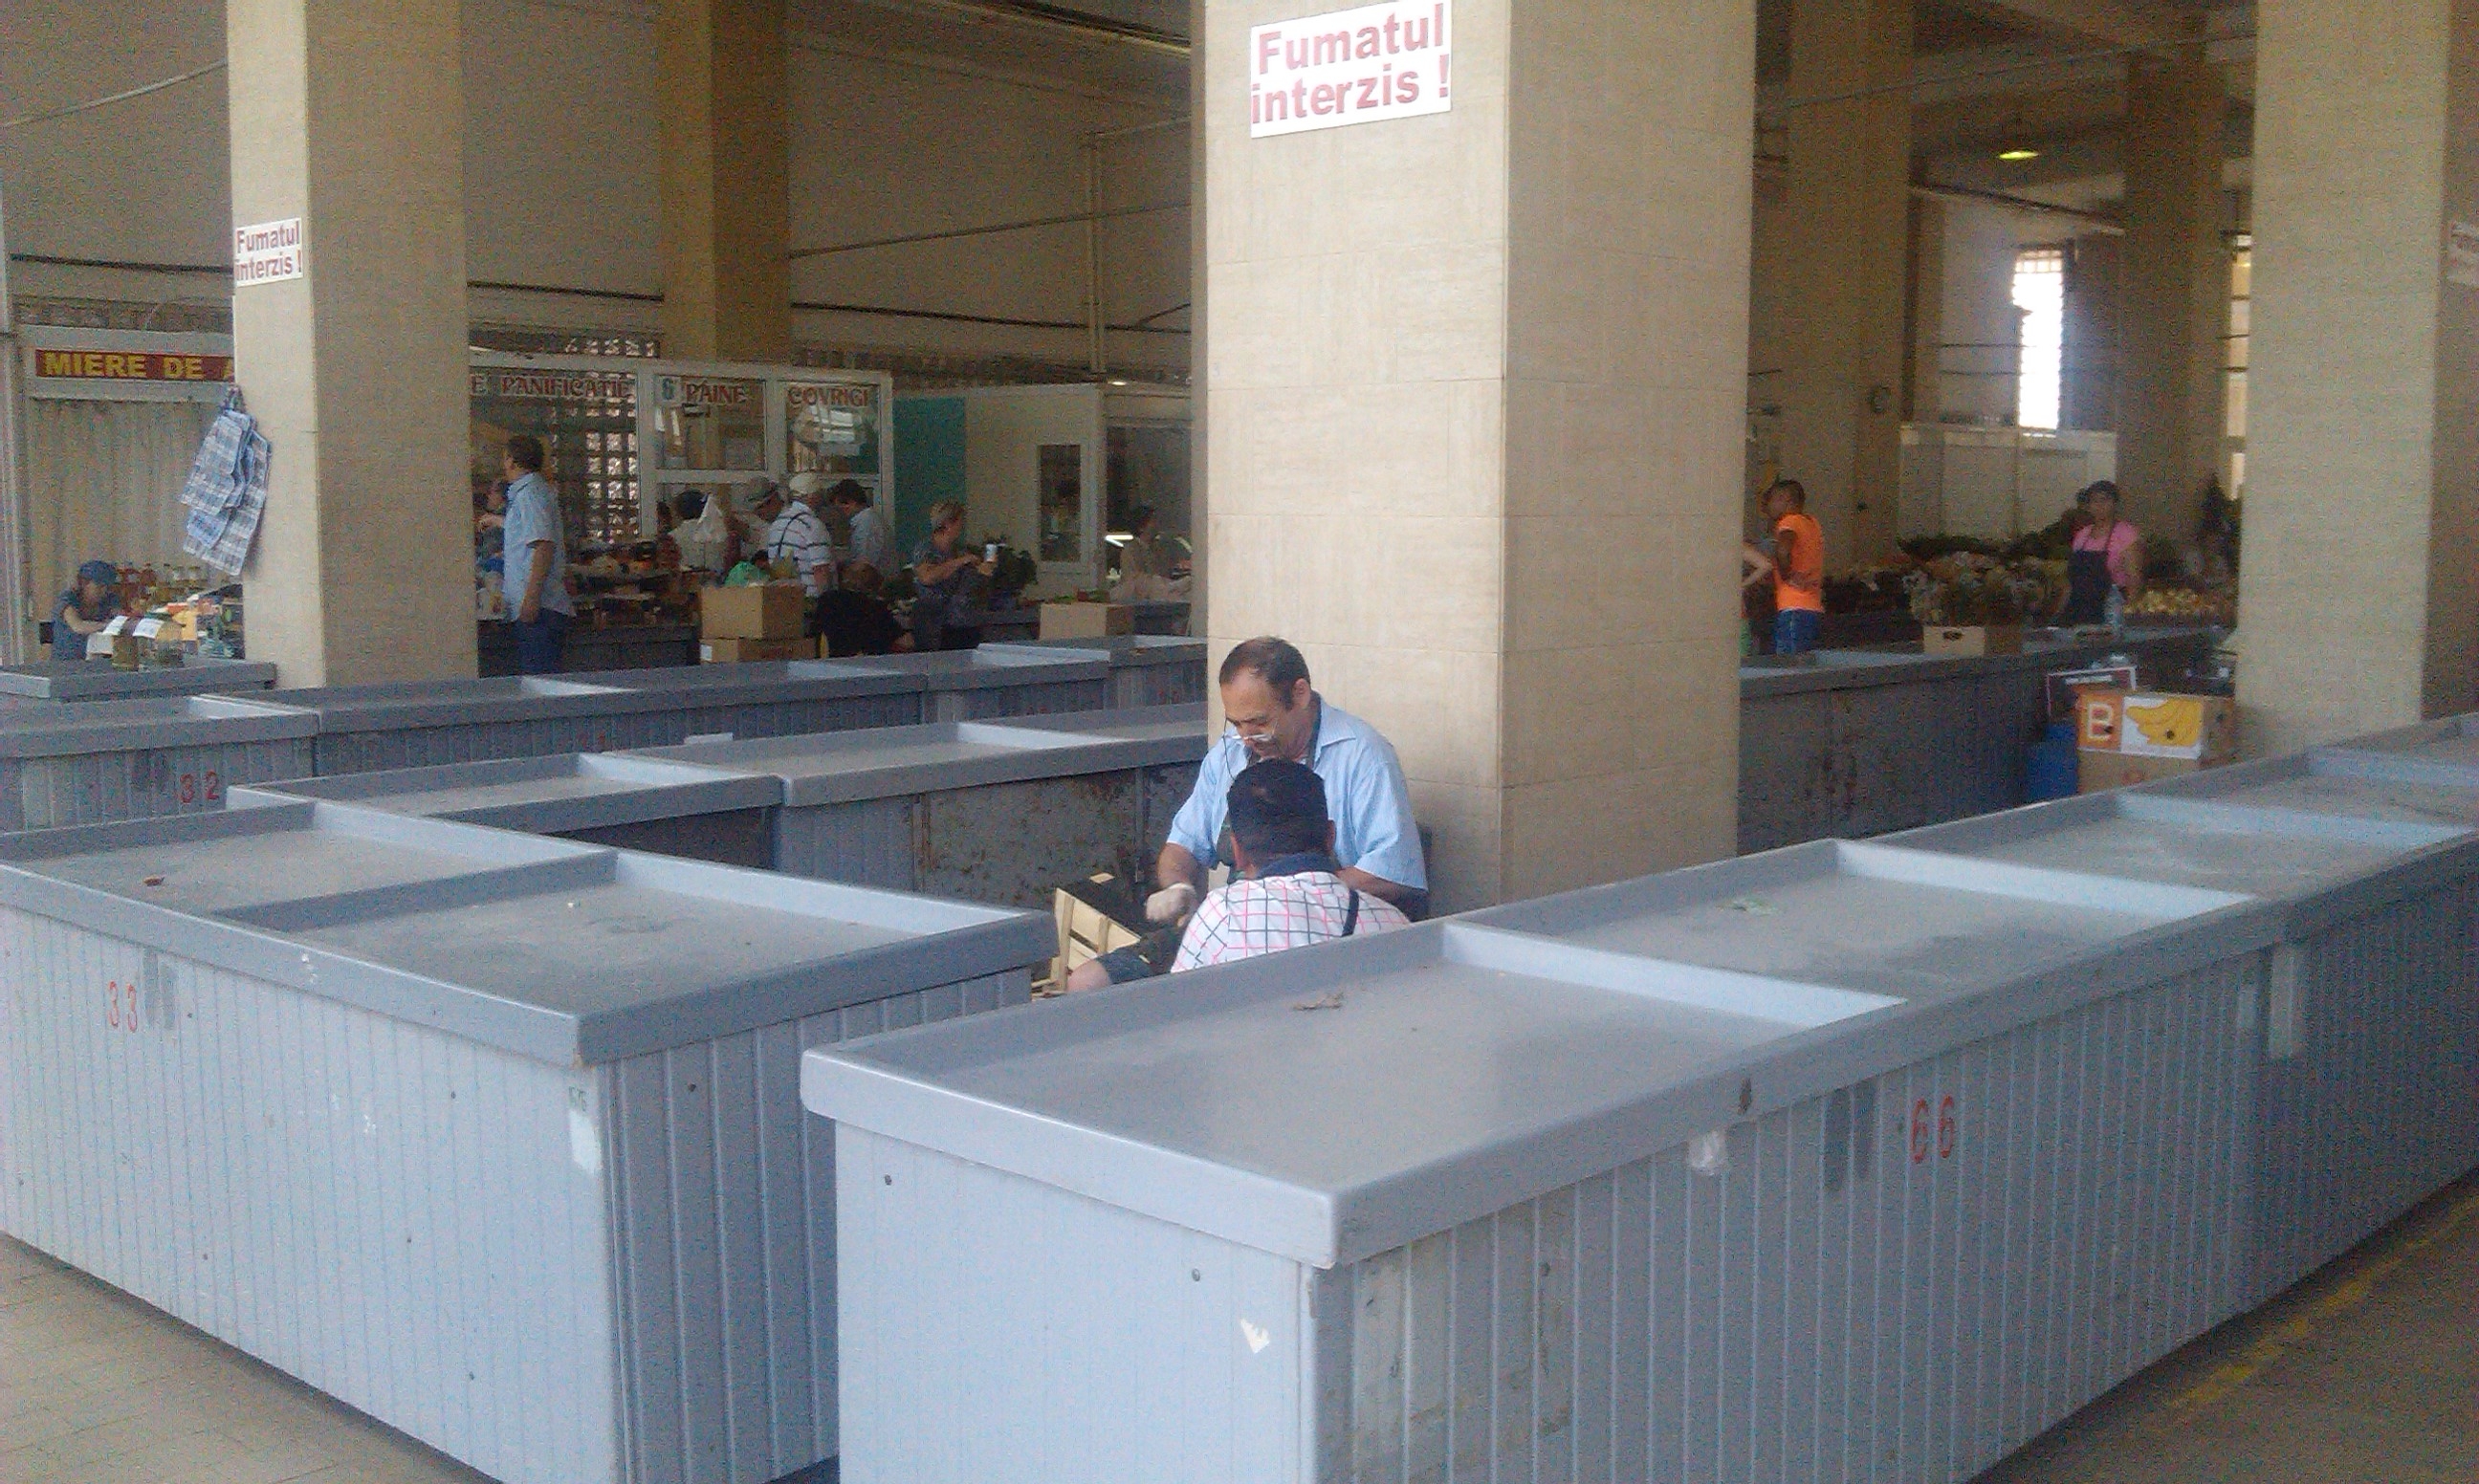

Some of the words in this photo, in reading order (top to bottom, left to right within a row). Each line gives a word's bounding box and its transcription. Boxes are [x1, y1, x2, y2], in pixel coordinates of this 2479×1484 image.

[1259, 3, 1443, 75] Fumatul
[1251, 63, 1420, 124] interzis
[236, 221, 299, 254] Fumatul
[234, 251, 294, 280] interzis
[43, 351, 147, 379] MIERE
[162, 357, 204, 379] DE
[2088, 702, 2115, 739] B
[179, 771, 220, 803] 32
[108, 981, 138, 1033] 33
[1910, 1095, 1955, 1164] 66
